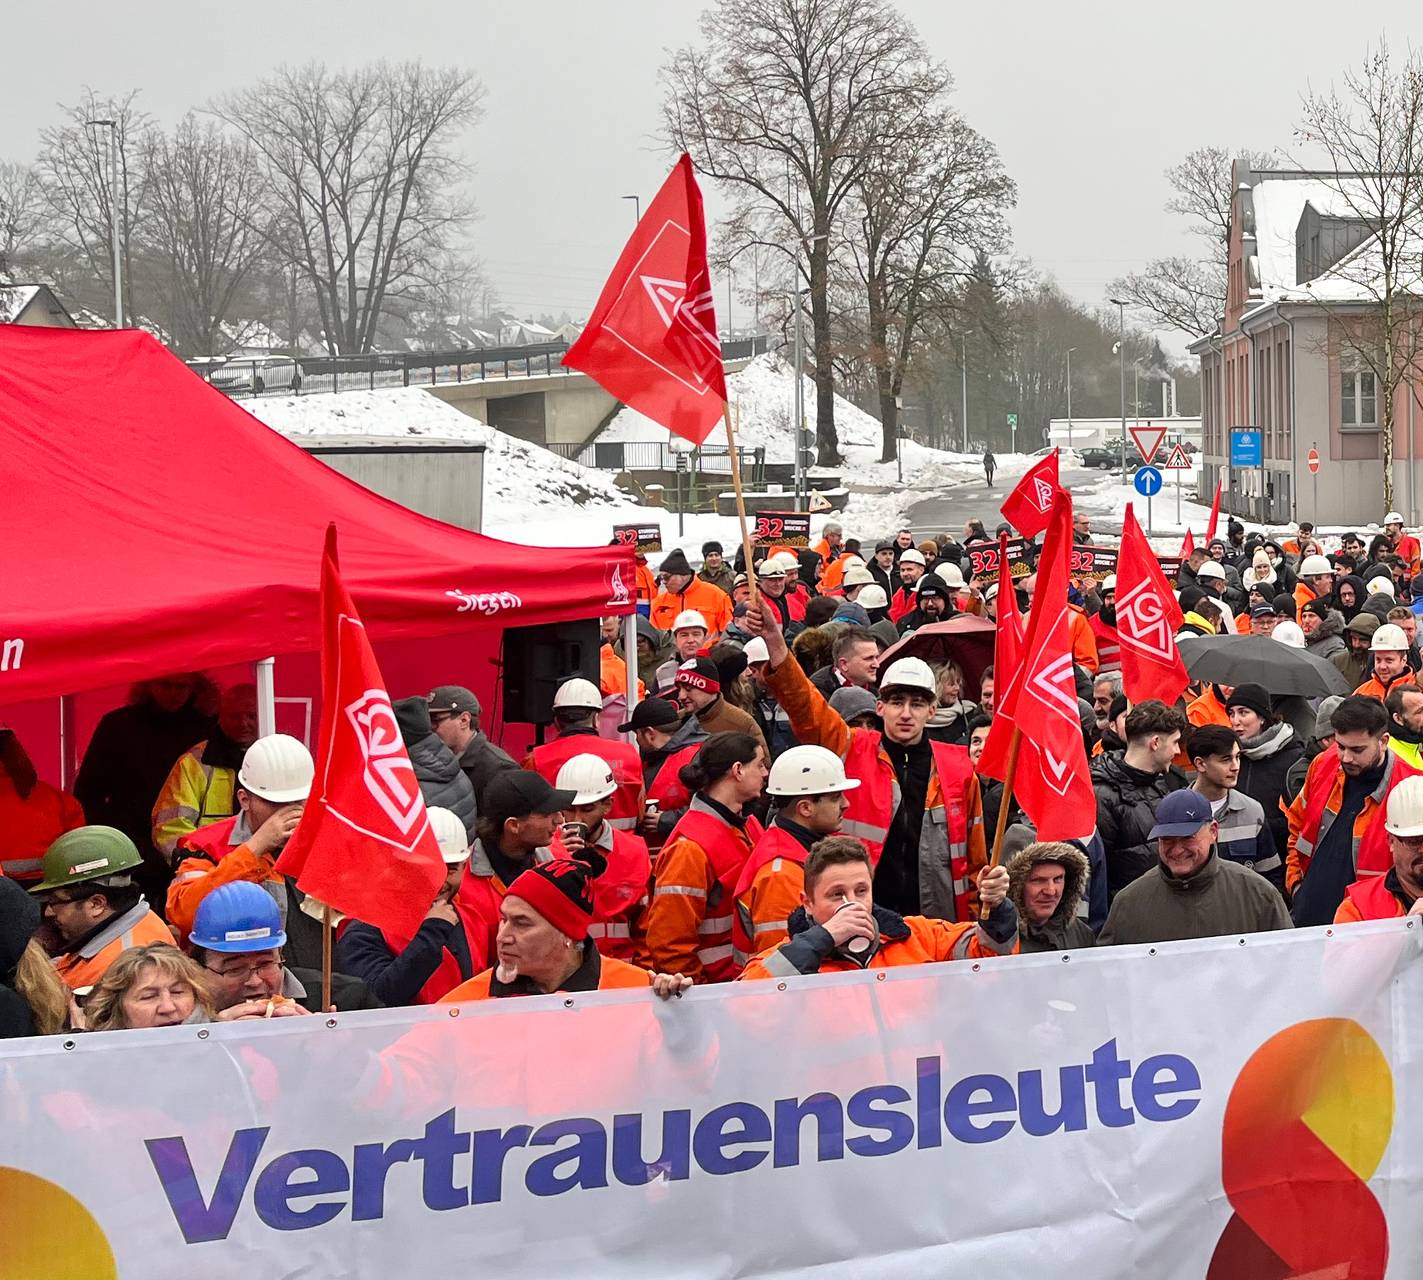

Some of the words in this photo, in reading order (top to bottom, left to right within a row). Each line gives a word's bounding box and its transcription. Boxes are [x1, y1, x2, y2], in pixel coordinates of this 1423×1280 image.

[615, 529, 638, 545] 32
[757, 517, 784, 538] 32
[970, 549, 999, 574] 32
[1071, 551, 1093, 571] 32
[144, 1036, 1202, 1244] Vertrauensleute
